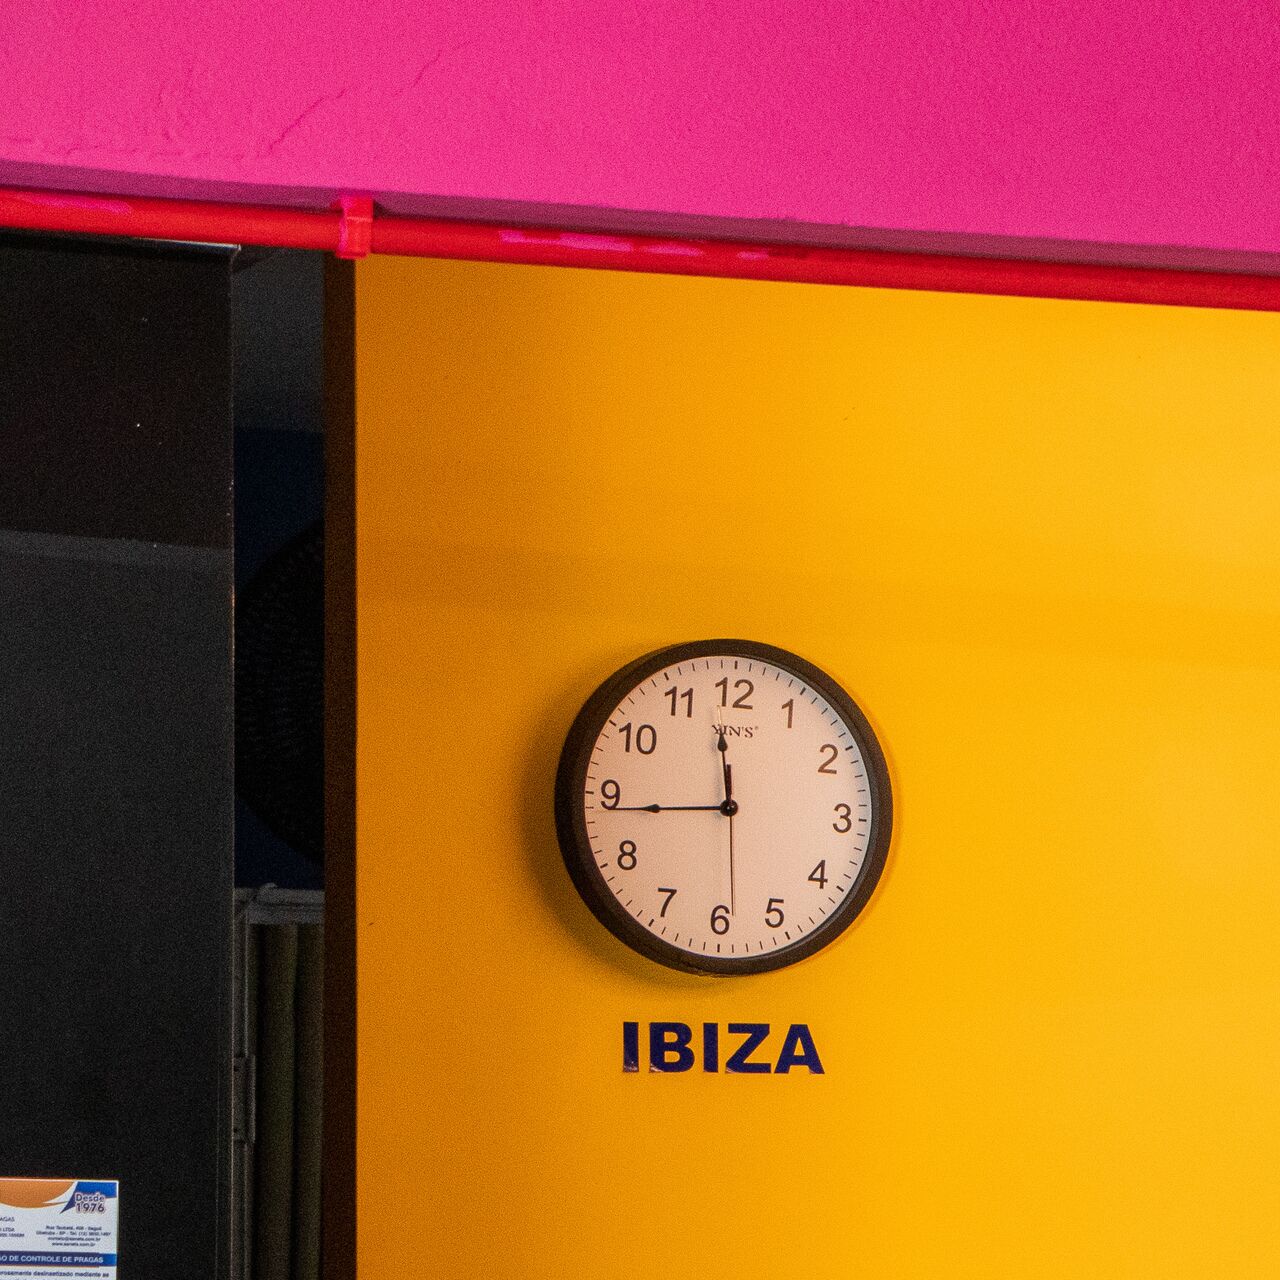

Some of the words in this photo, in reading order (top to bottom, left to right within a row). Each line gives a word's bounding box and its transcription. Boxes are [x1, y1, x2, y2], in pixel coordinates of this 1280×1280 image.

[664, 686, 695, 718] 11
[714, 677, 754, 709] 12
[781, 699, 795, 729] 1
[619, 723, 657, 754] 10
[818, 744, 838, 774] 2
[600, 779, 621, 810] 9
[832, 804, 852, 833] 3
[617, 840, 638, 870] 8
[808, 860, 828, 889] 4
[657, 887, 677, 918] 7
[764, 898, 785, 928] 5
[710, 905, 731, 935] 6
[622, 1021, 825, 1075] IBIZA
[76, 1193, 105, 1202] Desde
[76, 1203, 105, 1212] 1976
[74, 1256, 103, 1264] PRAGAS
